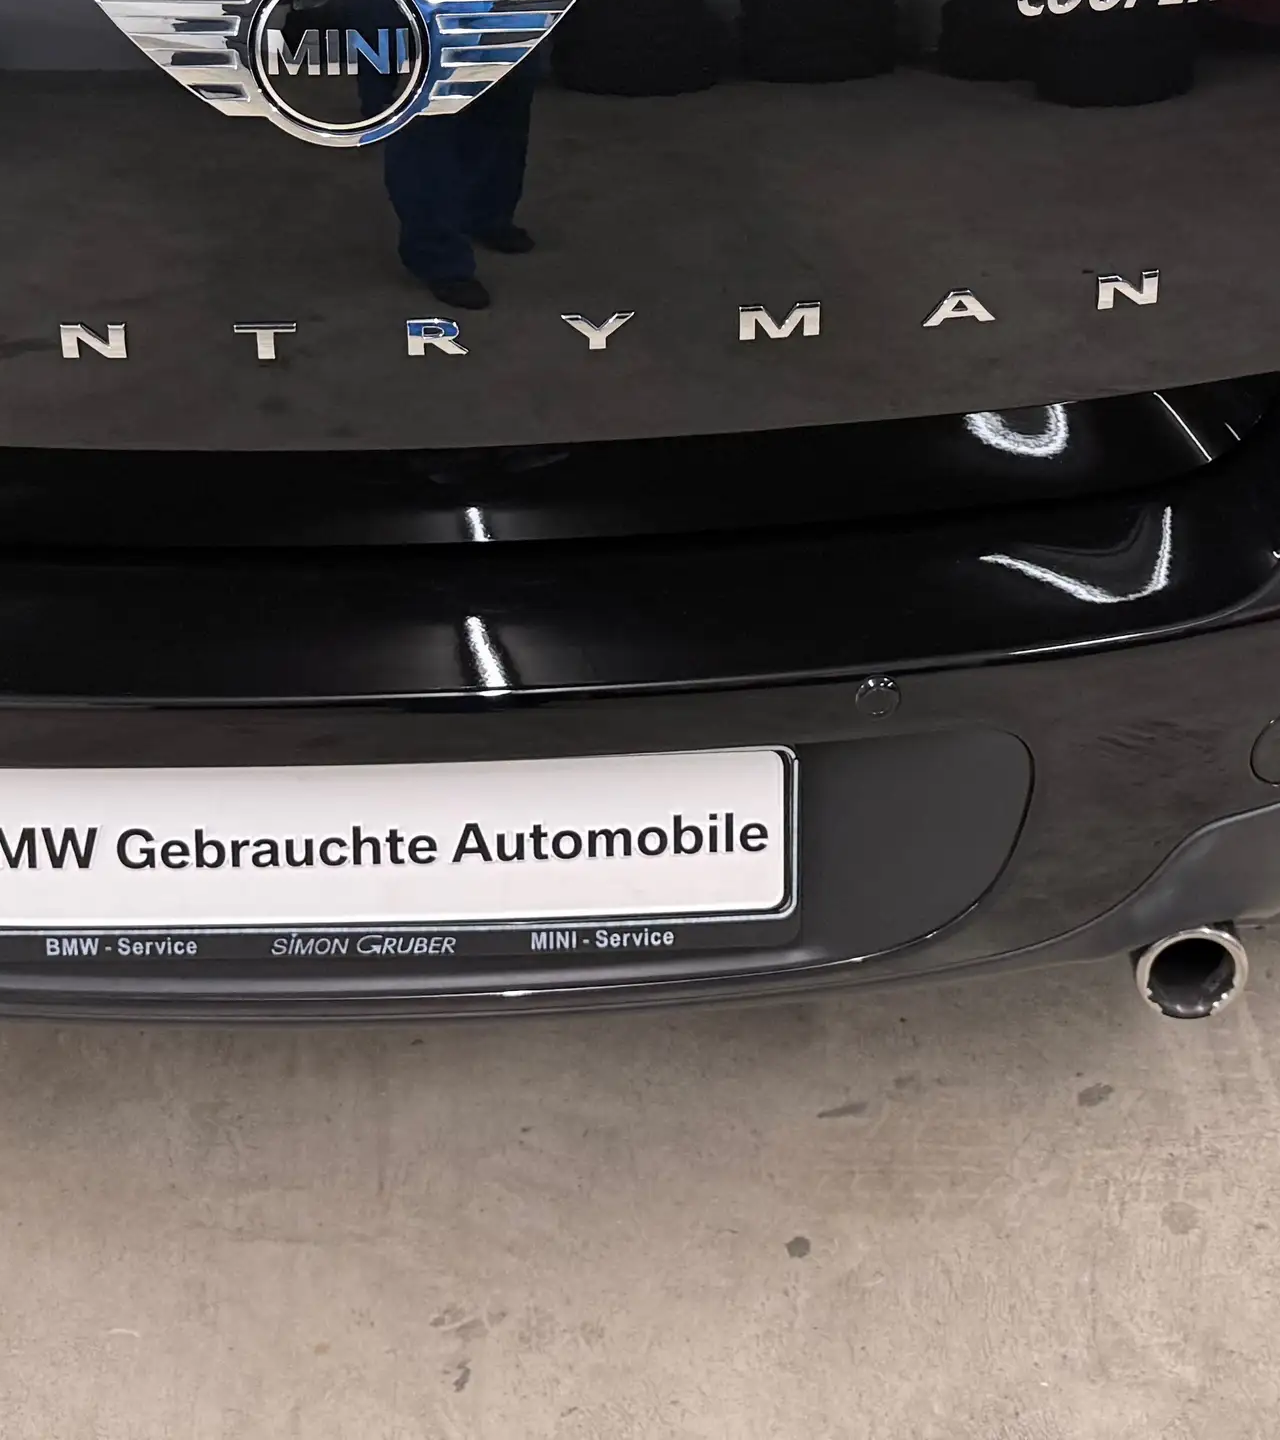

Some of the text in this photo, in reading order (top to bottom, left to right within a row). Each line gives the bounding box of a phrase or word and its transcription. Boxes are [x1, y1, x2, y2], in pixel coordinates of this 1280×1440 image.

[267, 28, 410, 76] MINI
[117, 825, 437, 869] Gebrauchte
[452, 813, 769, 863] Automobile
[46, 938, 99, 956] BMW
[117, 936, 198, 956] Service
[356, 934, 456, 955] GRUBER
[530, 930, 577, 950] MINI
[595, 928, 674, 949] Service
